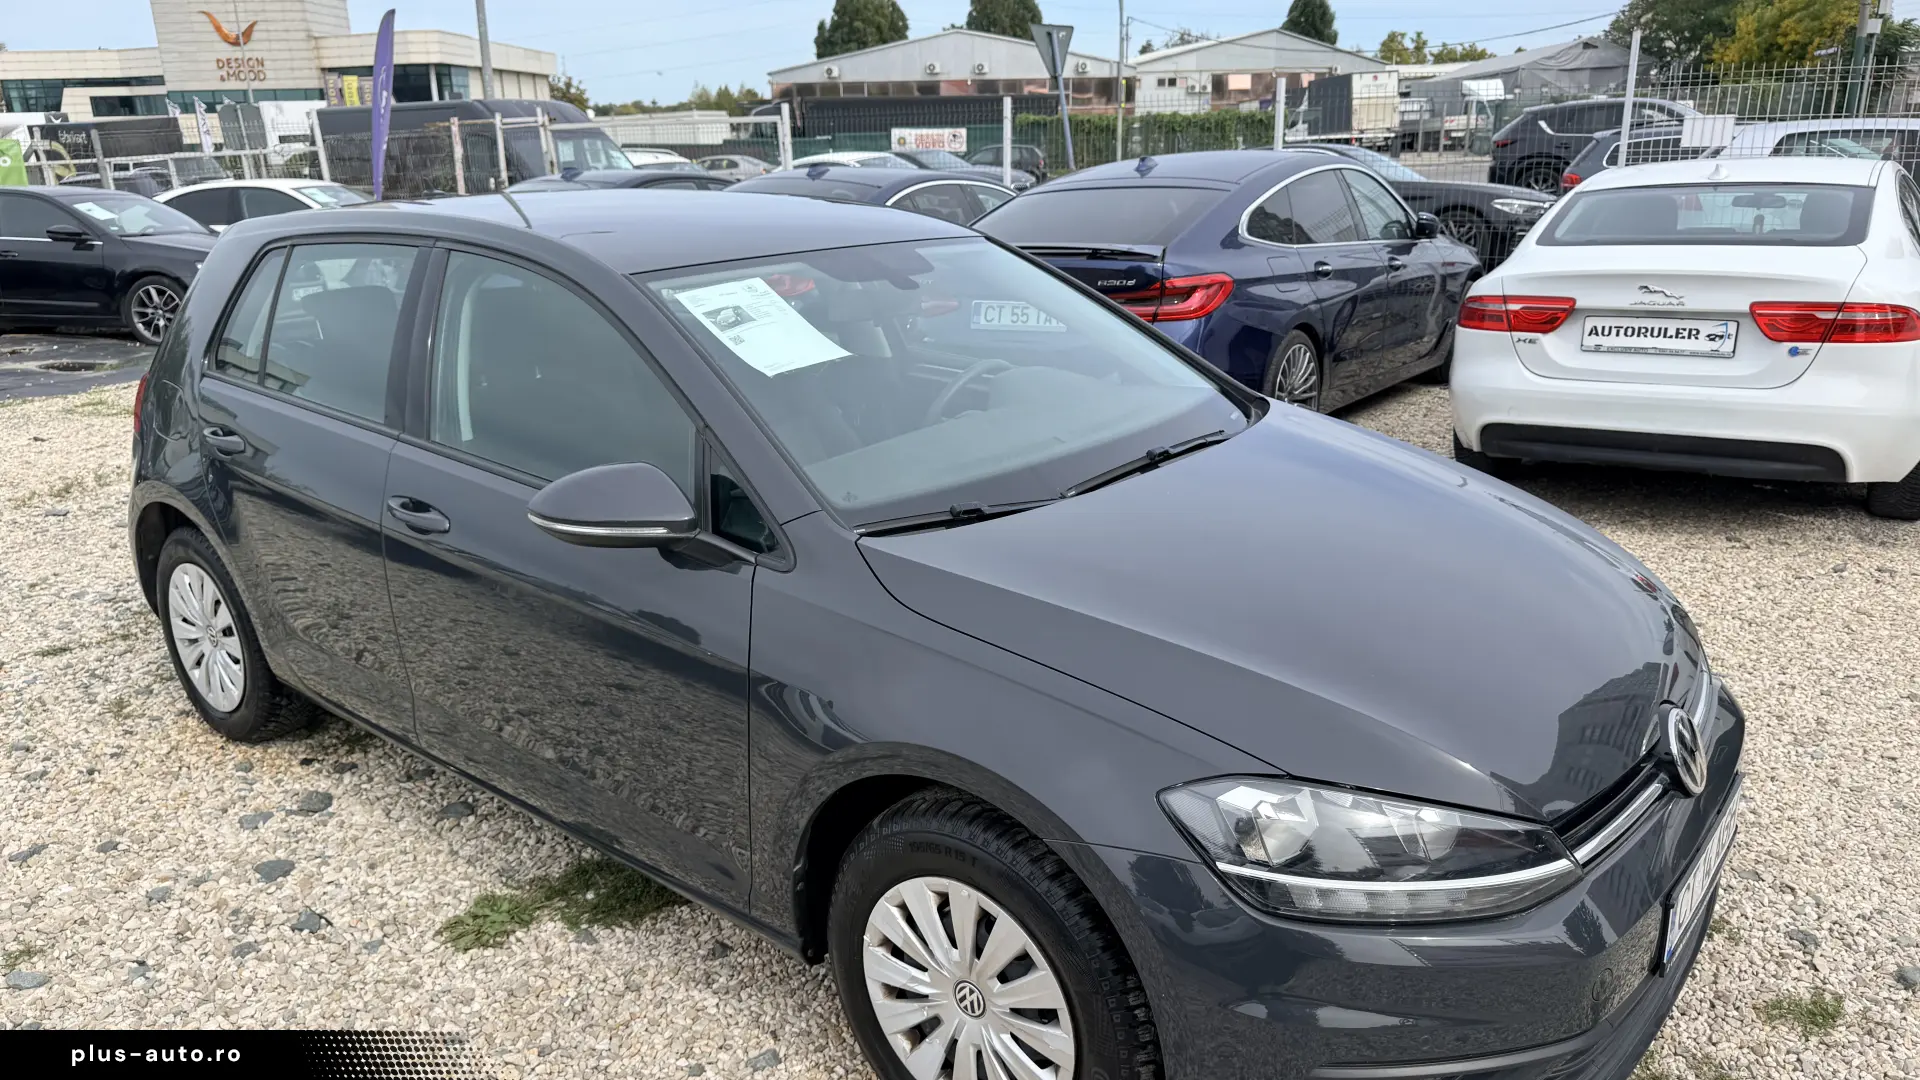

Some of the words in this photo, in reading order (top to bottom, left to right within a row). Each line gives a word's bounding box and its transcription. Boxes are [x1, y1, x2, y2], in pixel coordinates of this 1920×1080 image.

[216, 57, 264, 69] DESIGN
[984, 305, 1005, 323] CT
[1011, 305, 1030, 324] 55
[1587, 324, 1701, 340] AUTORULER
[908, 841, 941, 854] 195/65
[944, 846, 952, 857] R
[954, 849, 965, 862] 15
